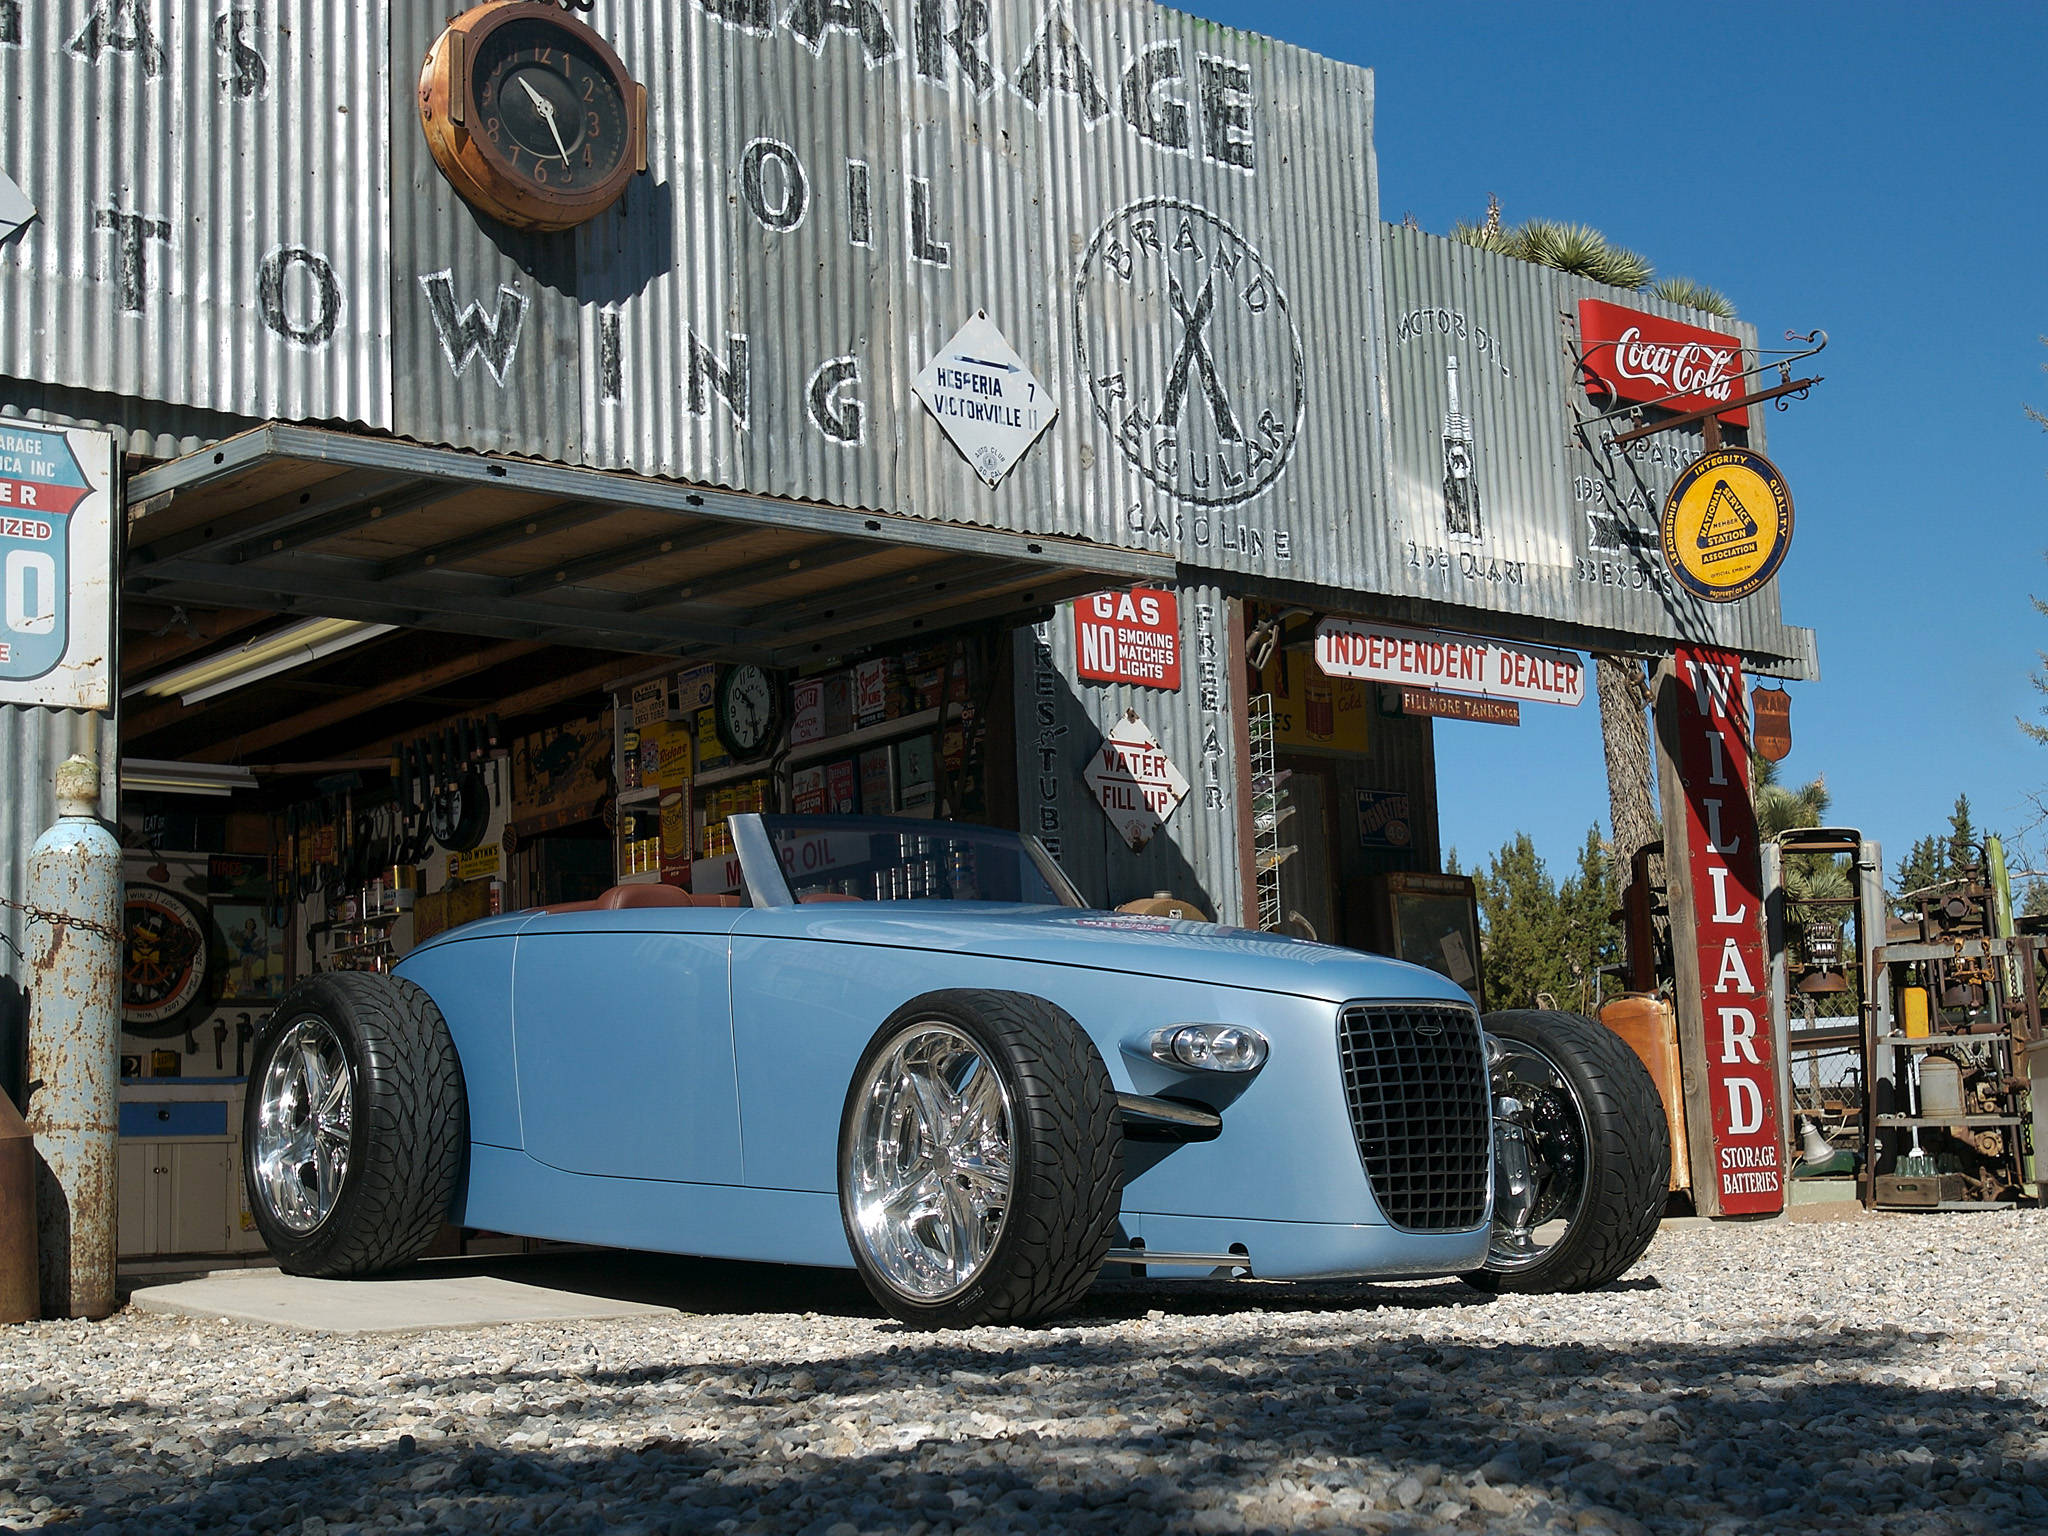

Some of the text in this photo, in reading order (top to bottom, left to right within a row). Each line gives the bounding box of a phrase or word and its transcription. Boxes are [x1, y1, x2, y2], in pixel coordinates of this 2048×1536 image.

[582, 77, 595, 102] 2
[486, 118, 500, 143] 8
[587, 111, 600, 137] 3
[534, 159, 547, 183] 6
[739, 135, 951, 269] OIL
[1102, 215, 1272, 315] BRAND
[1396, 308, 1467, 350] MOTOR
[1615, 326, 1733, 403] Coca-Cola
[937, 367, 1036, 403] HESPERIA 7
[934, 394, 1022, 428] VICTORVILLE
[1096, 371, 1285, 494] REGULAR
[31, 459, 55, 478] INC
[1694, 454, 1748, 476] INTEGRITY
[1700, 487, 1722, 538] NATIONAL
[1713, 518, 1739, 529] MEMBER
[1722, 487, 1752, 527] SERVICE
[1769, 479, 1786, 539] QUALITY
[1126, 504, 1291, 563] GASOLINE
[1664, 500, 1680, 567] LEADERSHIP
[1707, 530, 1747, 548] STATION
[1459, 551, 1526, 587] QUART
[1703, 544, 1756, 564] ASSOCIATION
[1093, 593, 1160, 625] GAS
[1082, 622, 1174, 673] NO SMOKING
[1118, 645, 1174, 665] MATCHES
[1196, 604, 1219, 714] FREE
[1326, 628, 1578, 697] INDEPENDENT DEALER
[1119, 662, 1164, 680] LIGHTS
[1404, 693, 1461, 714] FILLMORE
[1464, 701, 1500, 719] TANKS
[1103, 750, 1167, 779] WATER
[1202, 727, 1226, 812] AIR
[1103, 785, 1168, 815] FILL UP
[802, 837, 837, 871] OIL
[1685, 659, 1764, 1136] WILLARD
[1721, 1145, 1778, 1170] STORAGE
[1723, 1169, 1779, 1197] BATTERIES
